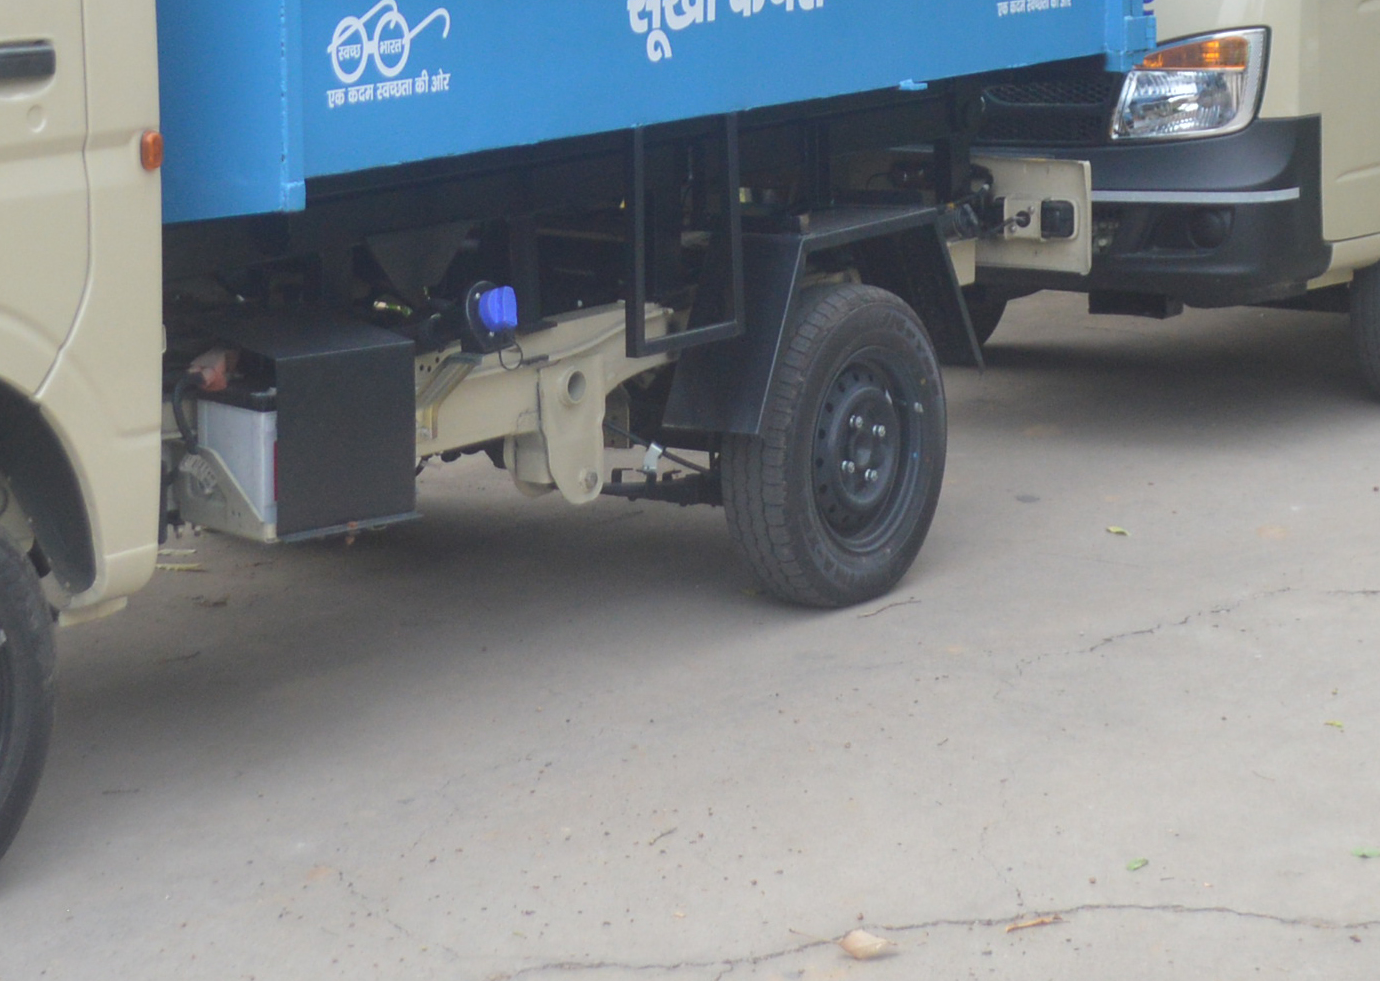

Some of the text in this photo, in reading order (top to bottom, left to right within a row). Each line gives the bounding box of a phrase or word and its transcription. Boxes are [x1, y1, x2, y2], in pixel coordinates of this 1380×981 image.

[338, 38, 402, 61] स्वच्छ भारत
[326, 67, 451, 109] एक कदम स्वच्छता की ओर
